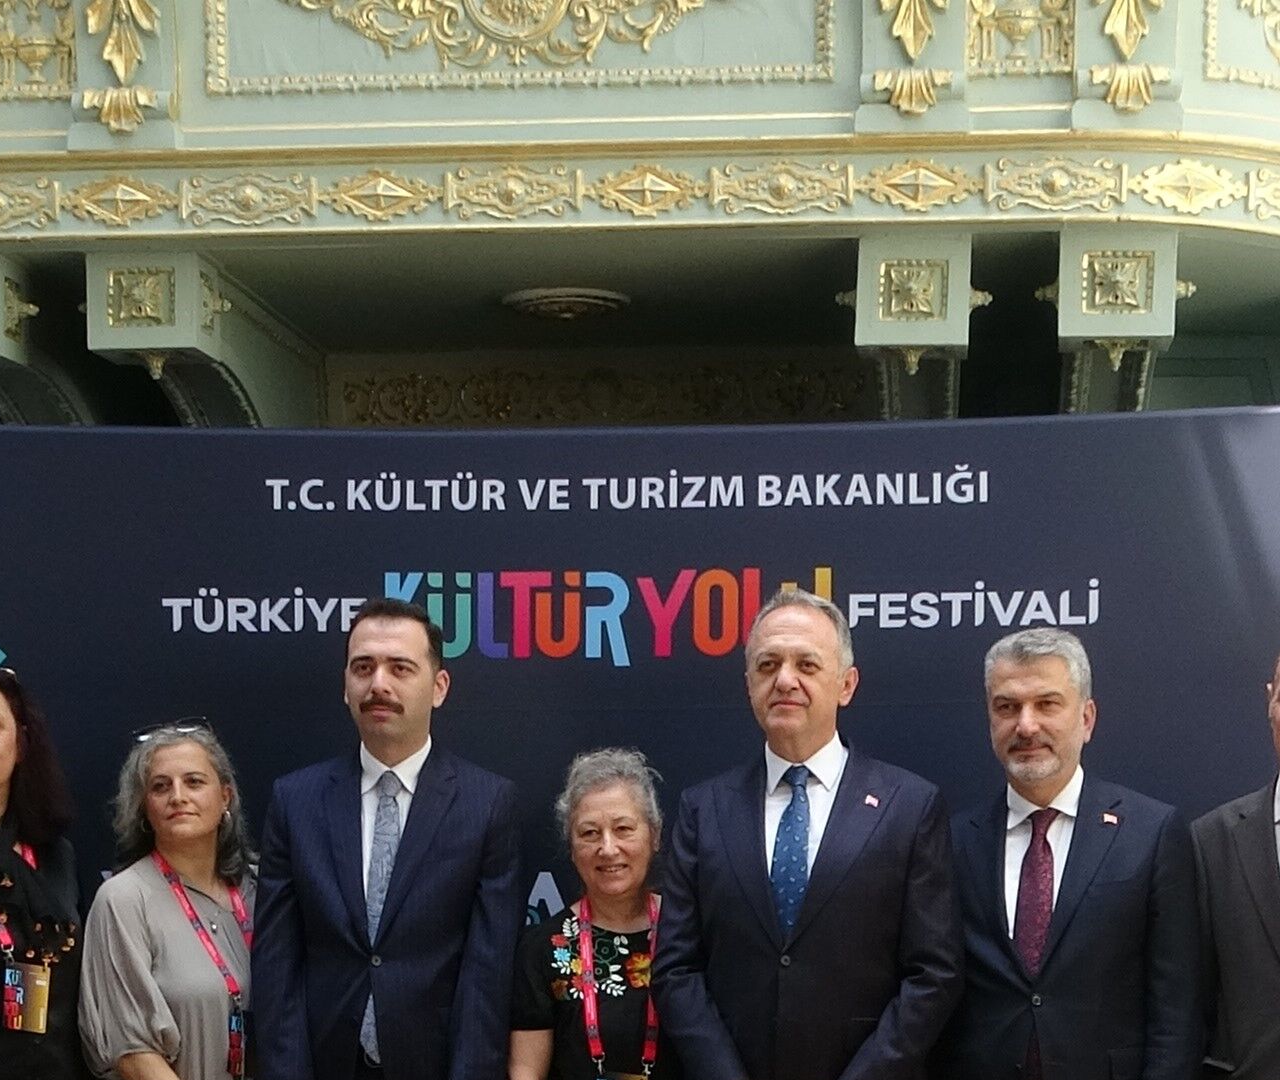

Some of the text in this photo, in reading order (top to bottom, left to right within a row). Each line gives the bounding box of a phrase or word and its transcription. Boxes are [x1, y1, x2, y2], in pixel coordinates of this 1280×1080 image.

[266, 464, 989, 511] T.C. KÜLTÜR VE TURİZM BAKANLIĞI
[849, 578, 1099, 628] FESTİVALİ
